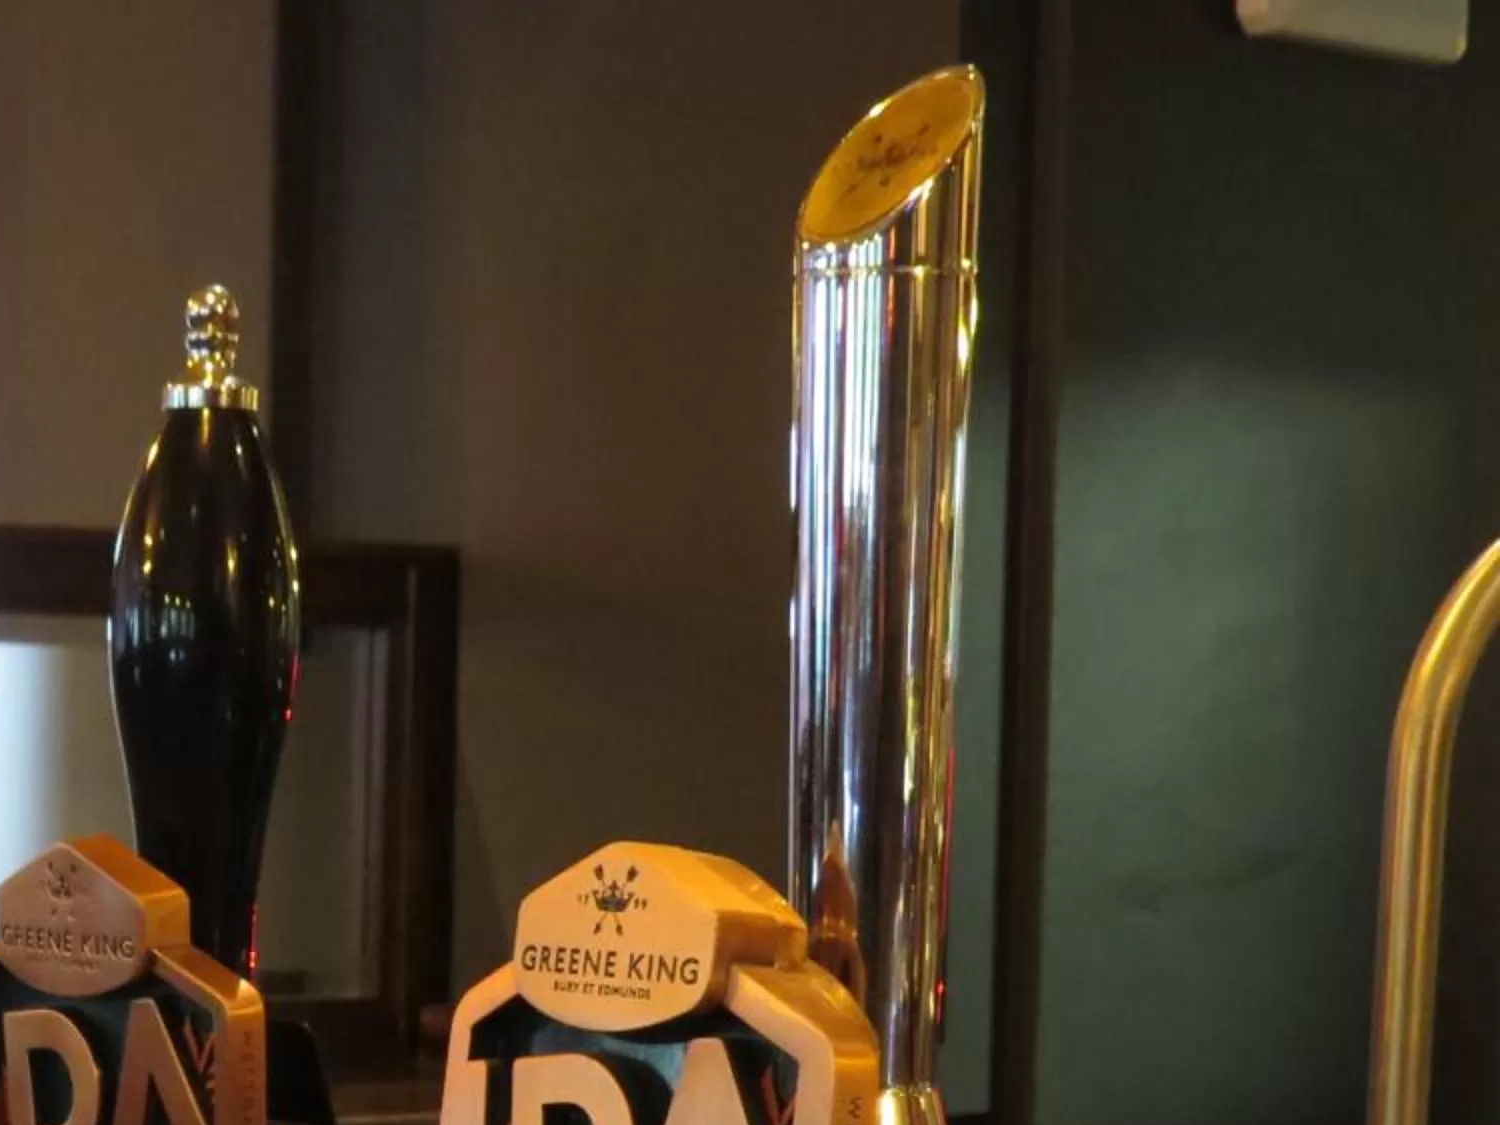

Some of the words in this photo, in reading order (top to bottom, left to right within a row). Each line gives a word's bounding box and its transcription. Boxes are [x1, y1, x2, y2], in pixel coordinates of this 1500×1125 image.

[1, 923, 73, 954] GREENE
[79, 932, 134, 961] KING
[521, 944, 617, 979] GREENE
[627, 951, 700, 985] KING
